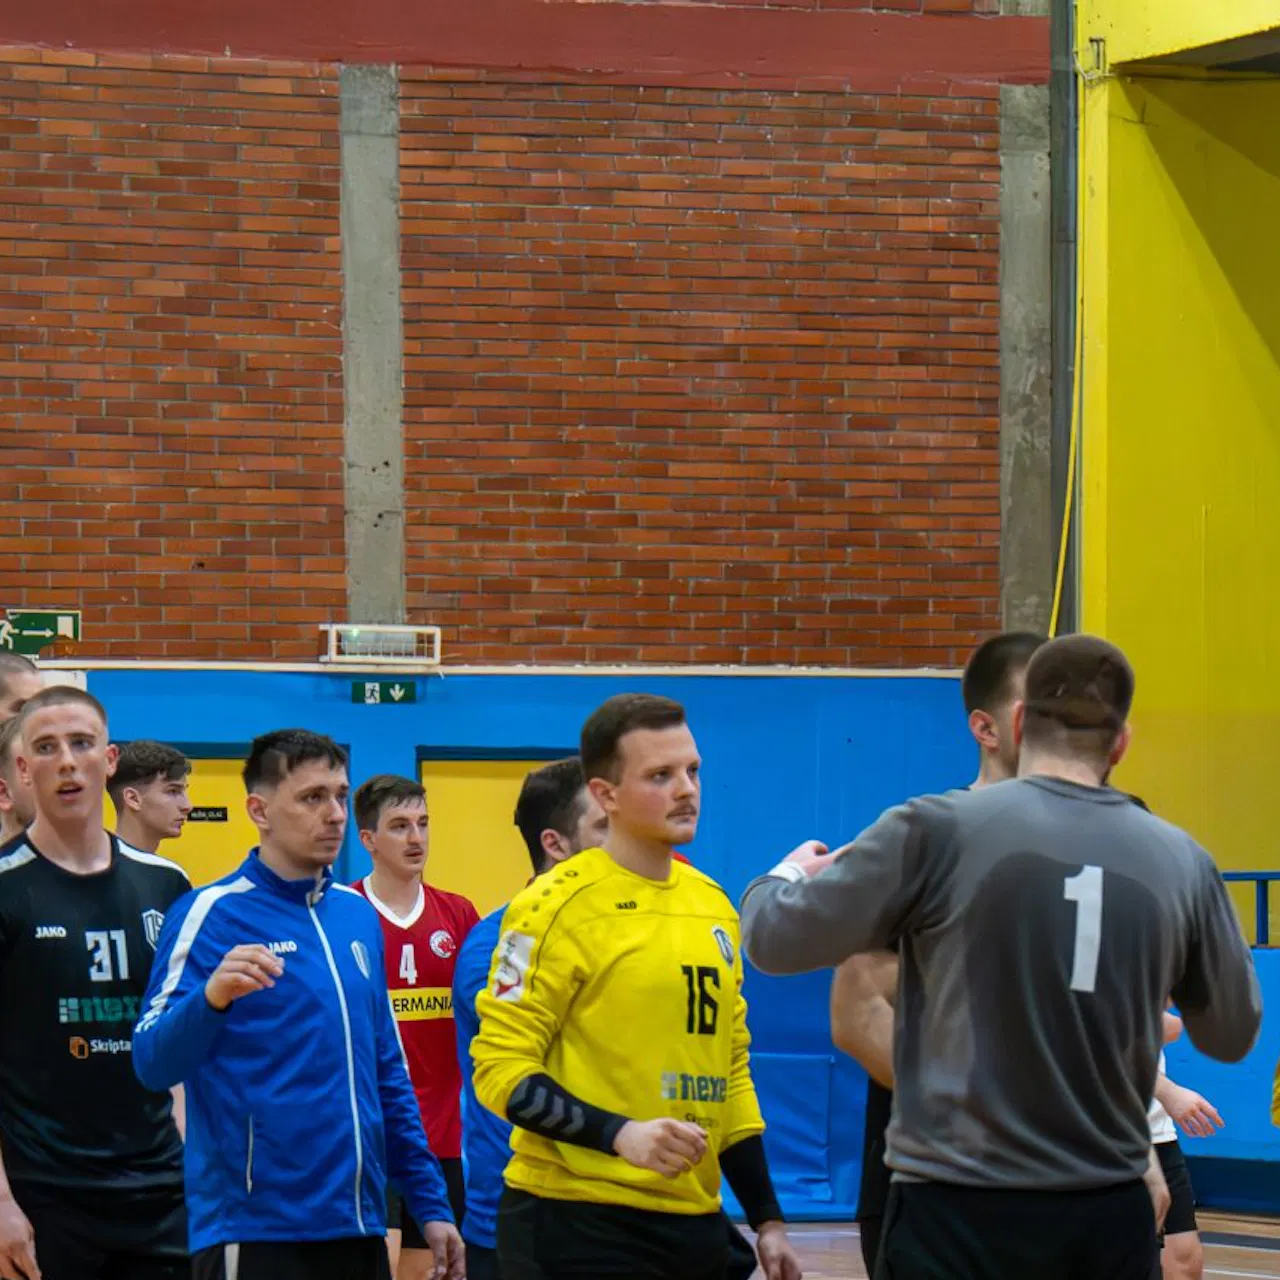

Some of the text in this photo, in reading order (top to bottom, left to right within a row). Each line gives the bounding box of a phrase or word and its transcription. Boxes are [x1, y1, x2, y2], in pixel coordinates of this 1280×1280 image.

[35, 926, 67, 939] JAKO
[1063, 865, 1104, 993] 1
[85, 929, 129, 981] 31
[399, 944, 418, 985] 4
[392, 997, 453, 1013] ERMANI
[681, 965, 722, 1036] 16
